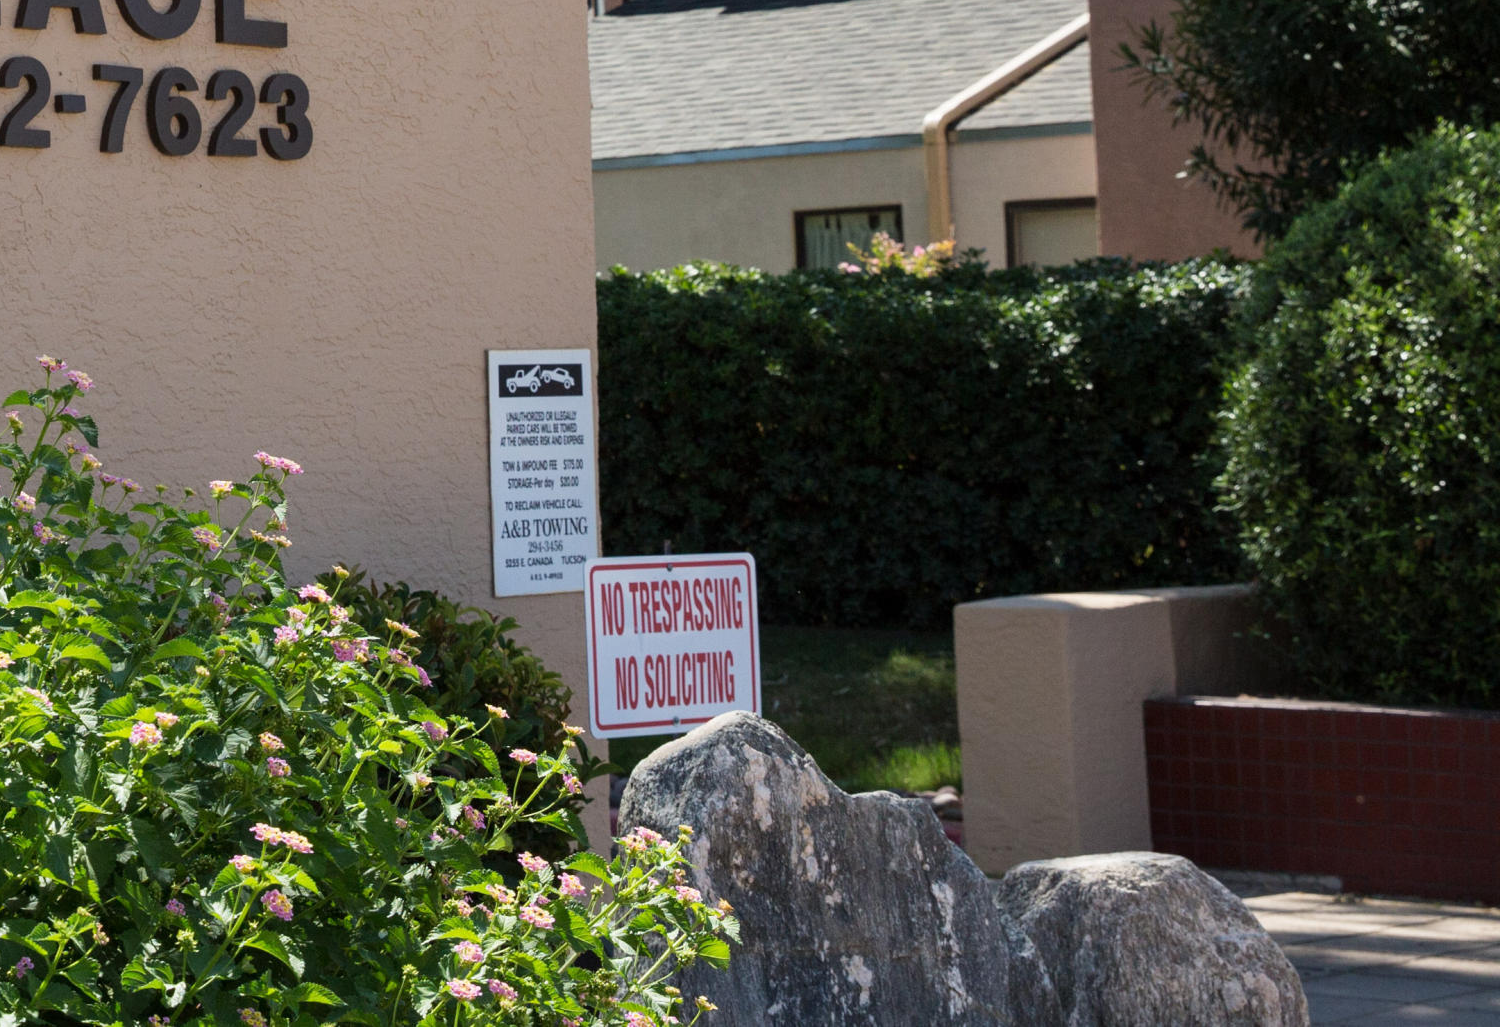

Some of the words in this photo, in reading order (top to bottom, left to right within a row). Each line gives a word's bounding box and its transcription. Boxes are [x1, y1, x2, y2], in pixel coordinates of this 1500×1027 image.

[506, 412, 544, 422] UNAUTHORIZED
[546, 411, 553, 421] OR
[554, 411, 577, 421] ILLEGALLY
[506, 423, 525, 434] PARKED
[527, 423, 540, 433] CARS
[541, 423, 552, 433] WILL
[553, 423, 559, 433] BE
[560, 422, 577, 433] TOWED
[500, 437, 506, 447] AT
[507, 436, 517, 446] THE
[518, 436, 539, 446] OWNERS
[540, 436, 551, 446] RISK
[552, 435, 563, 445] AND
[563, 435, 584, 445] EXPENSE
[502, 461, 515, 472] TOW
[516, 461, 521, 471] &
[522, 460, 548, 471] IMPOUND
[549, 460, 557, 470] FEE
[544, 477, 554, 490] day
[505, 501, 513, 511] TO
[515, 500, 541, 510] RECLAIM
[542, 500, 565, 509] VEHICLE
[501, 519, 531, 539] A&B
[533, 517, 589, 537] TOWING
[528, 557, 553, 566] CANADA
[561, 555, 587, 565] TUCSON
[601, 581, 625, 636] NO
[629, 577, 743, 635] TRESPASSING
[615, 656, 639, 711] NO
[644, 650, 735, 709] SOLICITING
